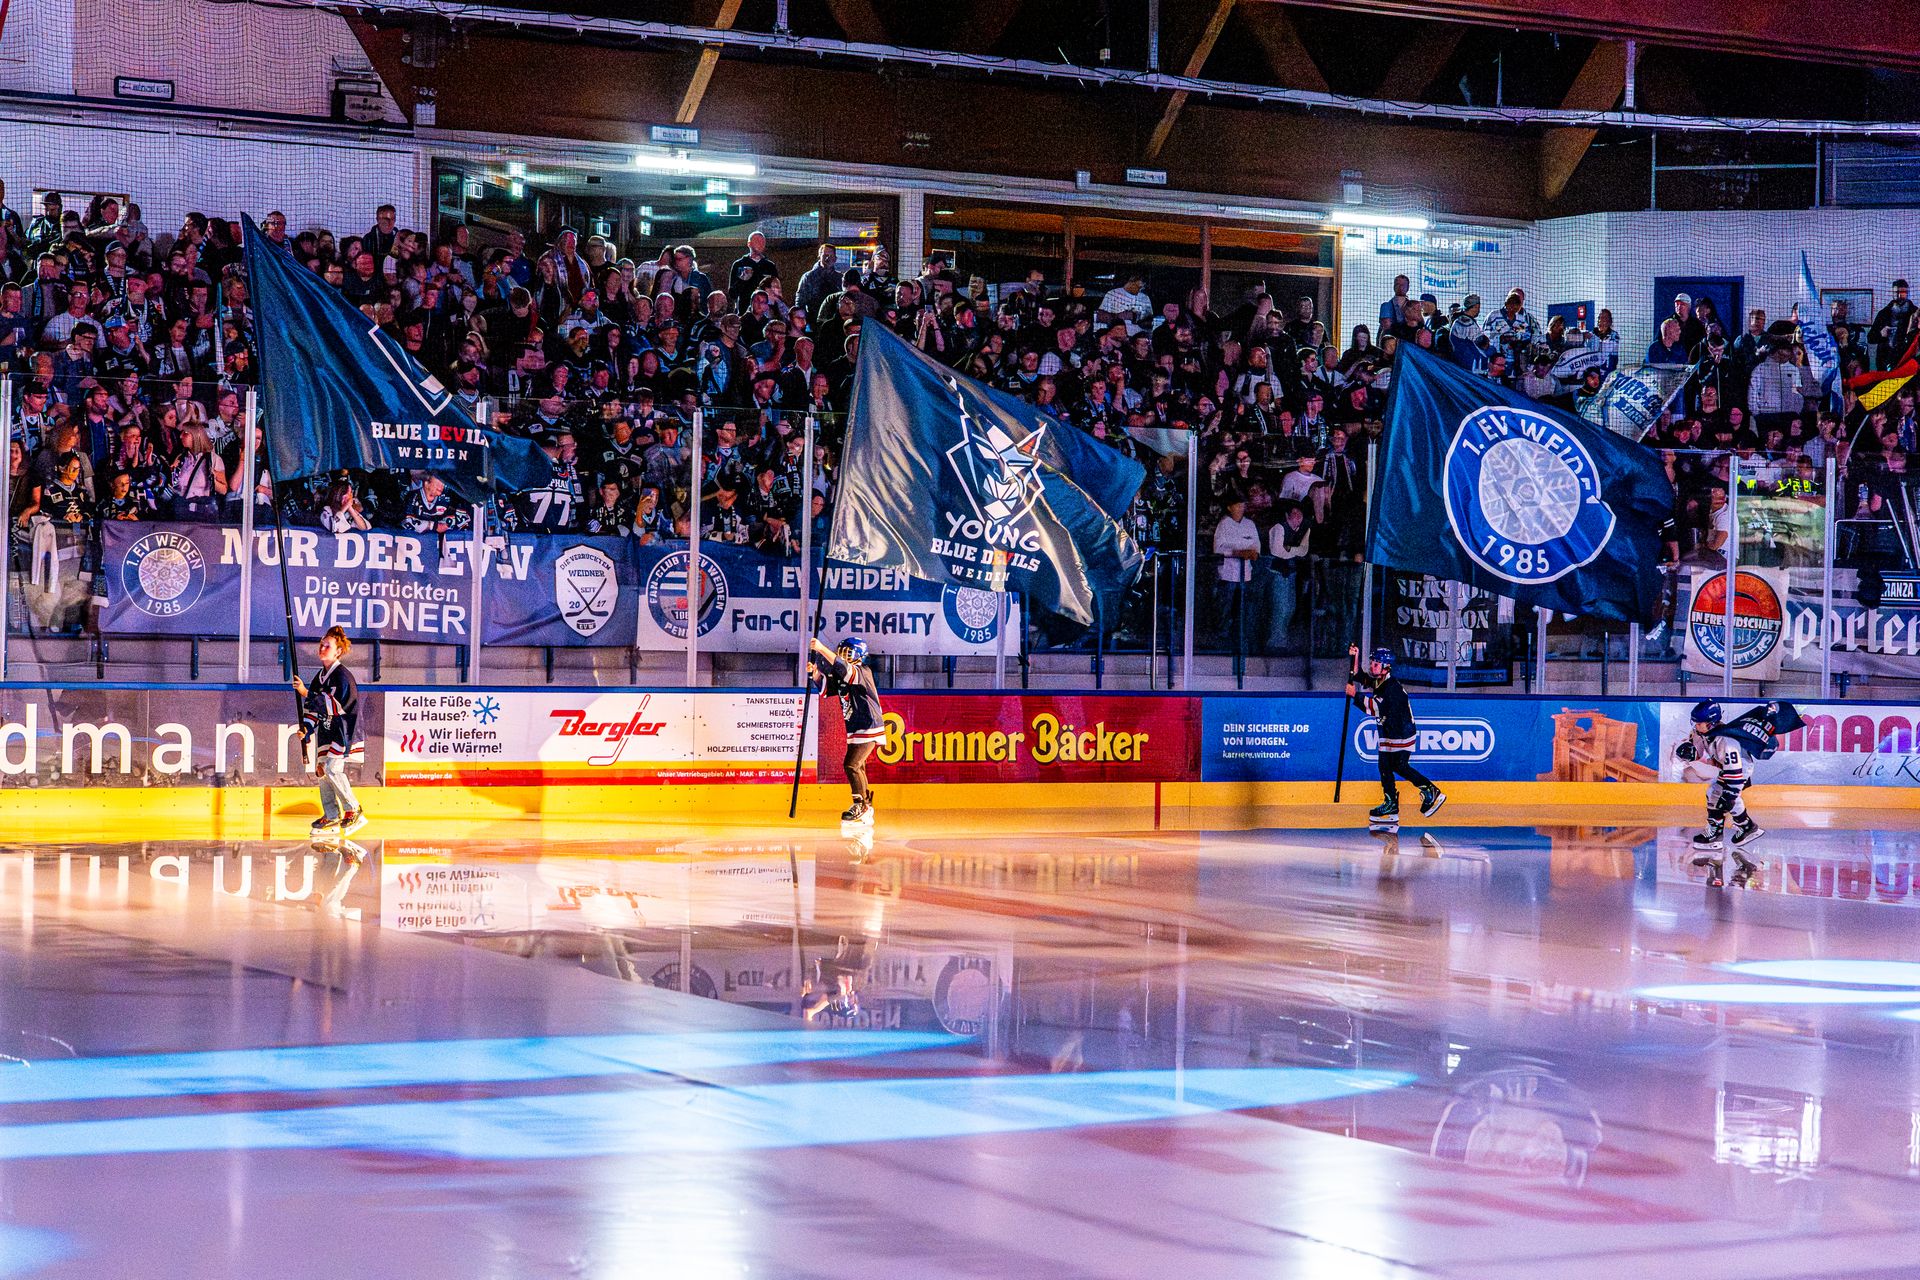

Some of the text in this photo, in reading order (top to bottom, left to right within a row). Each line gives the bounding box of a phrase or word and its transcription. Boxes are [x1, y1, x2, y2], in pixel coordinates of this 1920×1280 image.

[371, 421, 489, 448] BLUE DEVIL
[1477, 413, 1508, 441] EV
[398, 446, 468, 461] WEIDEN
[529, 491, 572, 526] 77
[945, 511, 1041, 552] YOUNG
[132, 539, 150, 558] EV
[155, 534, 202, 570] WEIDEN
[220, 528, 319, 568] NUR
[334, 532, 425, 573] DER
[930, 537, 1041, 572] BLUE DEVILS
[1481, 535, 1549, 574] 1985
[568, 569, 605, 578] WEIDNER
[757, 565, 772, 588] 1.
[817, 567, 910, 592] WEIDEN
[951, 564, 1011, 582] WEIDEN
[305, 576, 458, 602] Die verrückten
[709, 565, 724, 611] WEIDEN
[1881, 582, 1914, 598] RANZA
[146, 599, 181, 614] 1985
[569, 601, 581, 609] 20
[294, 596, 466, 635] WEIDNER
[835, 611, 935, 636] PENALTY
[963, 628, 992, 642] 1985
[402, 696, 472, 708] Kalte Füße
[746, 697, 795, 705] TANKSTELLEN
[401, 711, 467, 721] zu Hause?
[769, 708, 795, 717] HEIZÖL
[429, 728, 497, 740] Wir liefern
[550, 709, 667, 742] Bergler
[1223, 723, 1310, 733] DEIN SICHERER JOB
[429, 741, 502, 754] die Wärme!
[876, 712, 1149, 764] Brunner Bäcker
[1223, 737, 1289, 746] VON MORGEN.
[1363, 730, 1486, 751] WRON
[1222, 750, 1291, 759] karriere.witron.de
[1852, 745, 1885, 778] die
[400, 772, 453, 781] www.bergler.de
